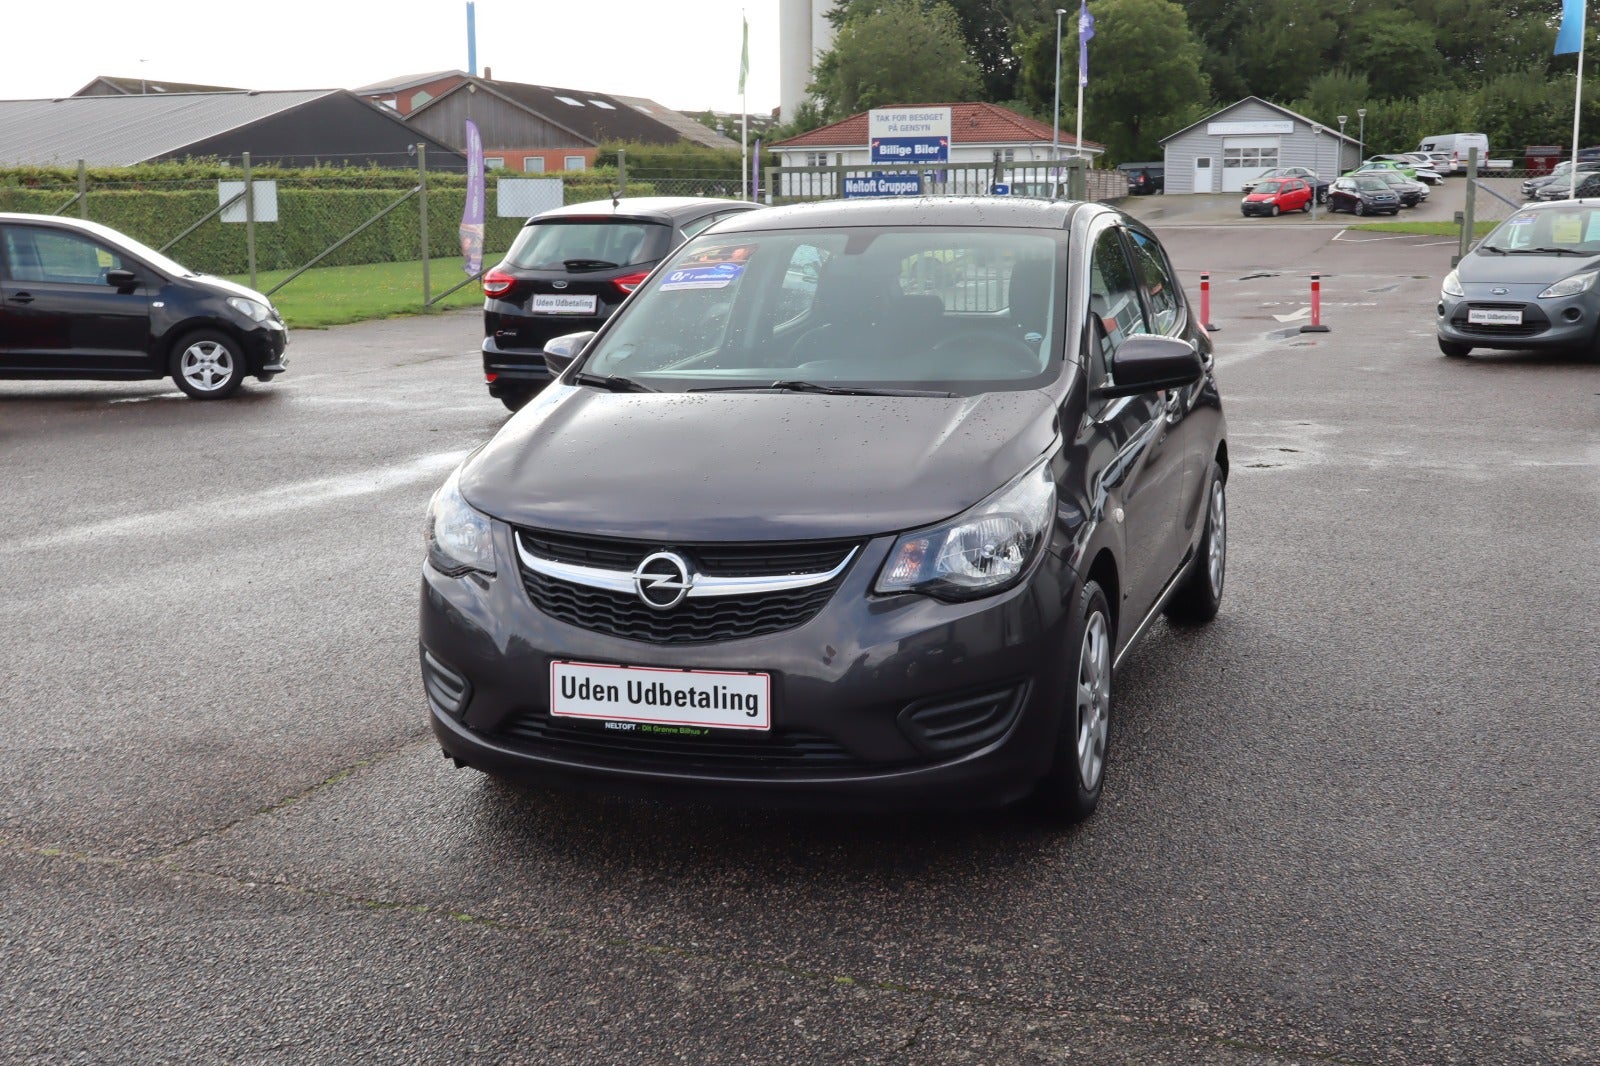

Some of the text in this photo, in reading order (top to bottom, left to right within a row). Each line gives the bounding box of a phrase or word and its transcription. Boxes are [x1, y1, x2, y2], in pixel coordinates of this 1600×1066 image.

[909, 113, 943, 121] BESØGET
[900, 124, 931, 132] GENSYN
[879, 144, 940, 156] Billige Biler
[845, 179, 918, 195] Neltoft Gruppen
[536, 298, 593, 309] Uden Udbetaling
[1487, 313, 1519, 321] Udbetaling
[561, 675, 758, 718] Uden Udbetaling
[605, 722, 636, 731] NELTOFT
[641, 724, 652, 732] Dit
[679, 727, 700, 735] Bilhus
